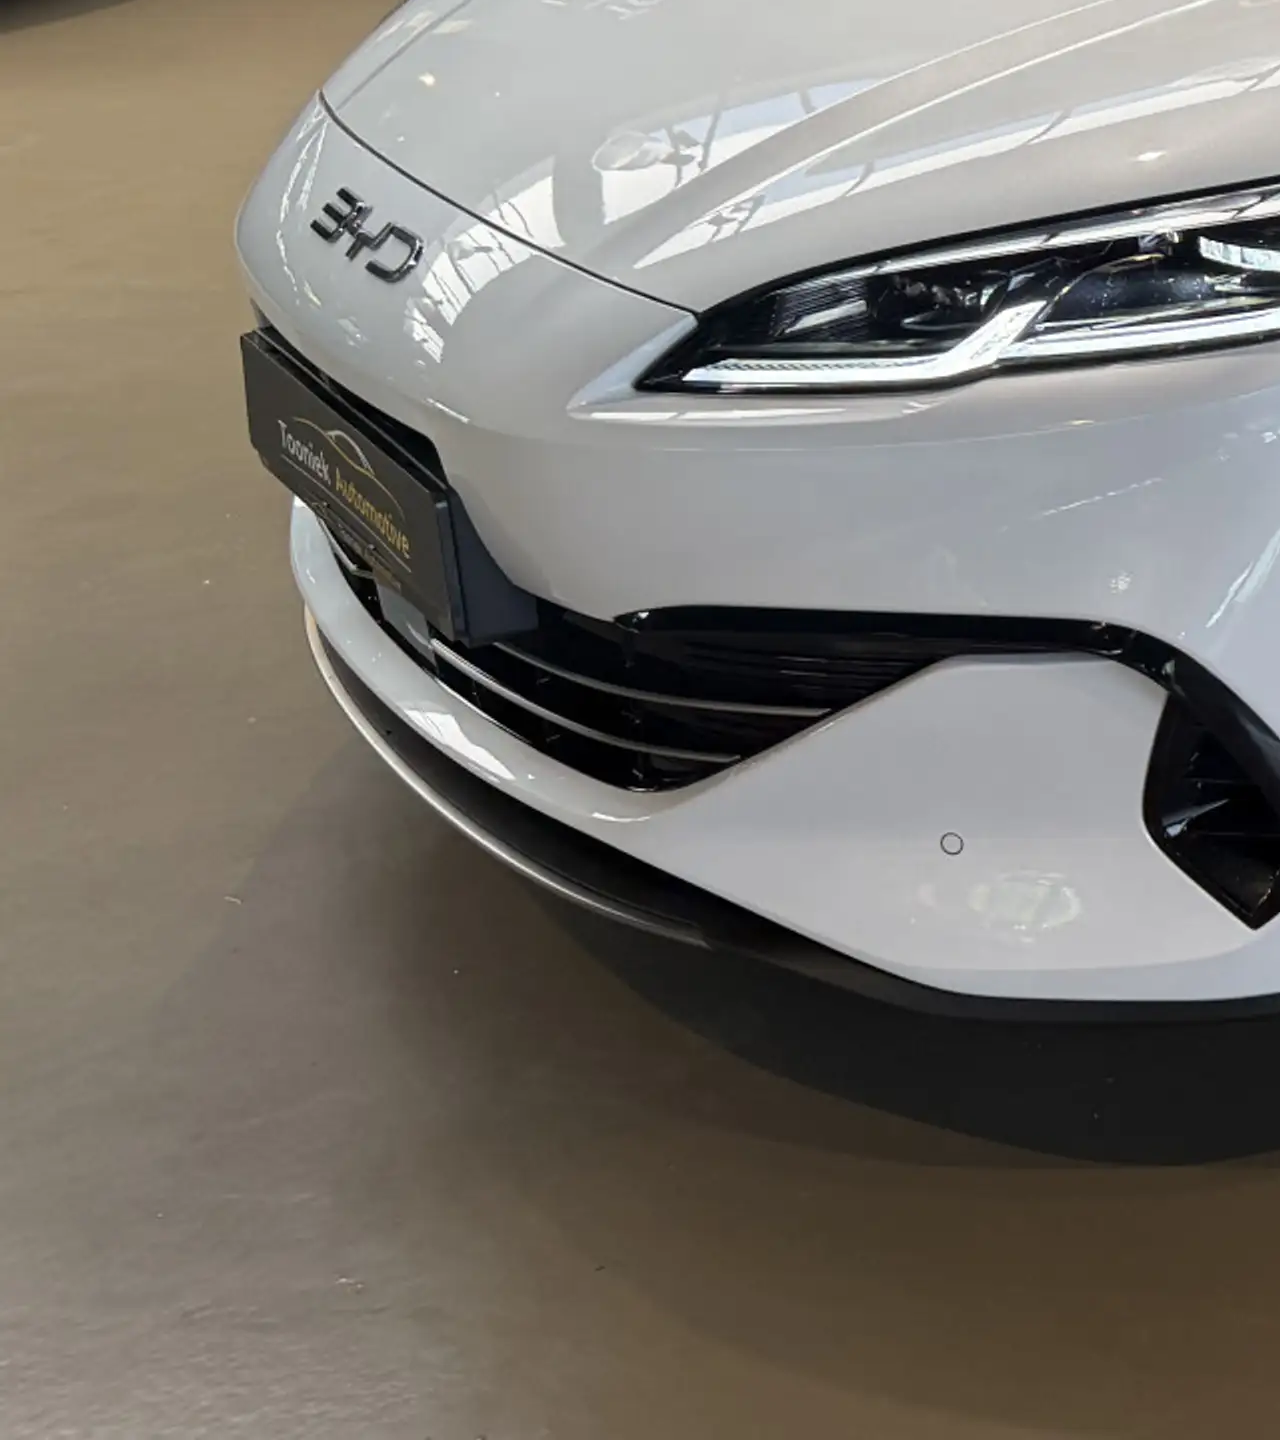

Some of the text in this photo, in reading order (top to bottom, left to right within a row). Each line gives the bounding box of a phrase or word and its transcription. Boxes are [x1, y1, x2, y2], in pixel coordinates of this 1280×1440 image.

[310, 188, 424, 284] BYD
[277, 419, 332, 486] Tooniek
[335, 467, 411, 560] Automotive
